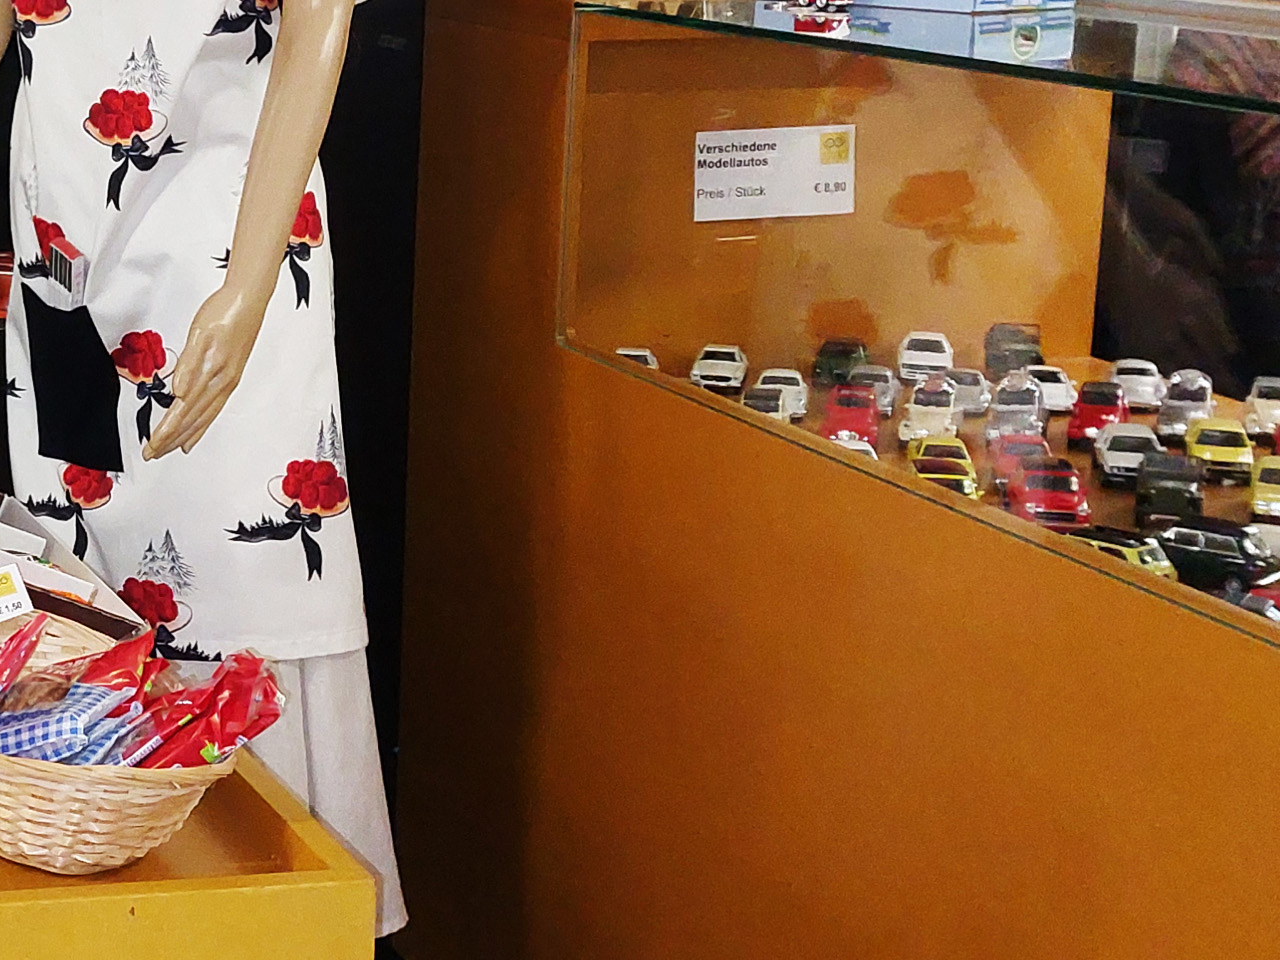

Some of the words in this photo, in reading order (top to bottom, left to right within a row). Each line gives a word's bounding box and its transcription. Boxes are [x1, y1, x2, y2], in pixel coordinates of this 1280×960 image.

[698, 141, 777, 155] Verschiedene
[697, 157, 769, 169] Modellautos
[697, 188, 725, 199] Preis
[735, 186, 766, 198] Stück
[814, 182, 821, 193] €
[5, 601, 22, 613] 1,50
